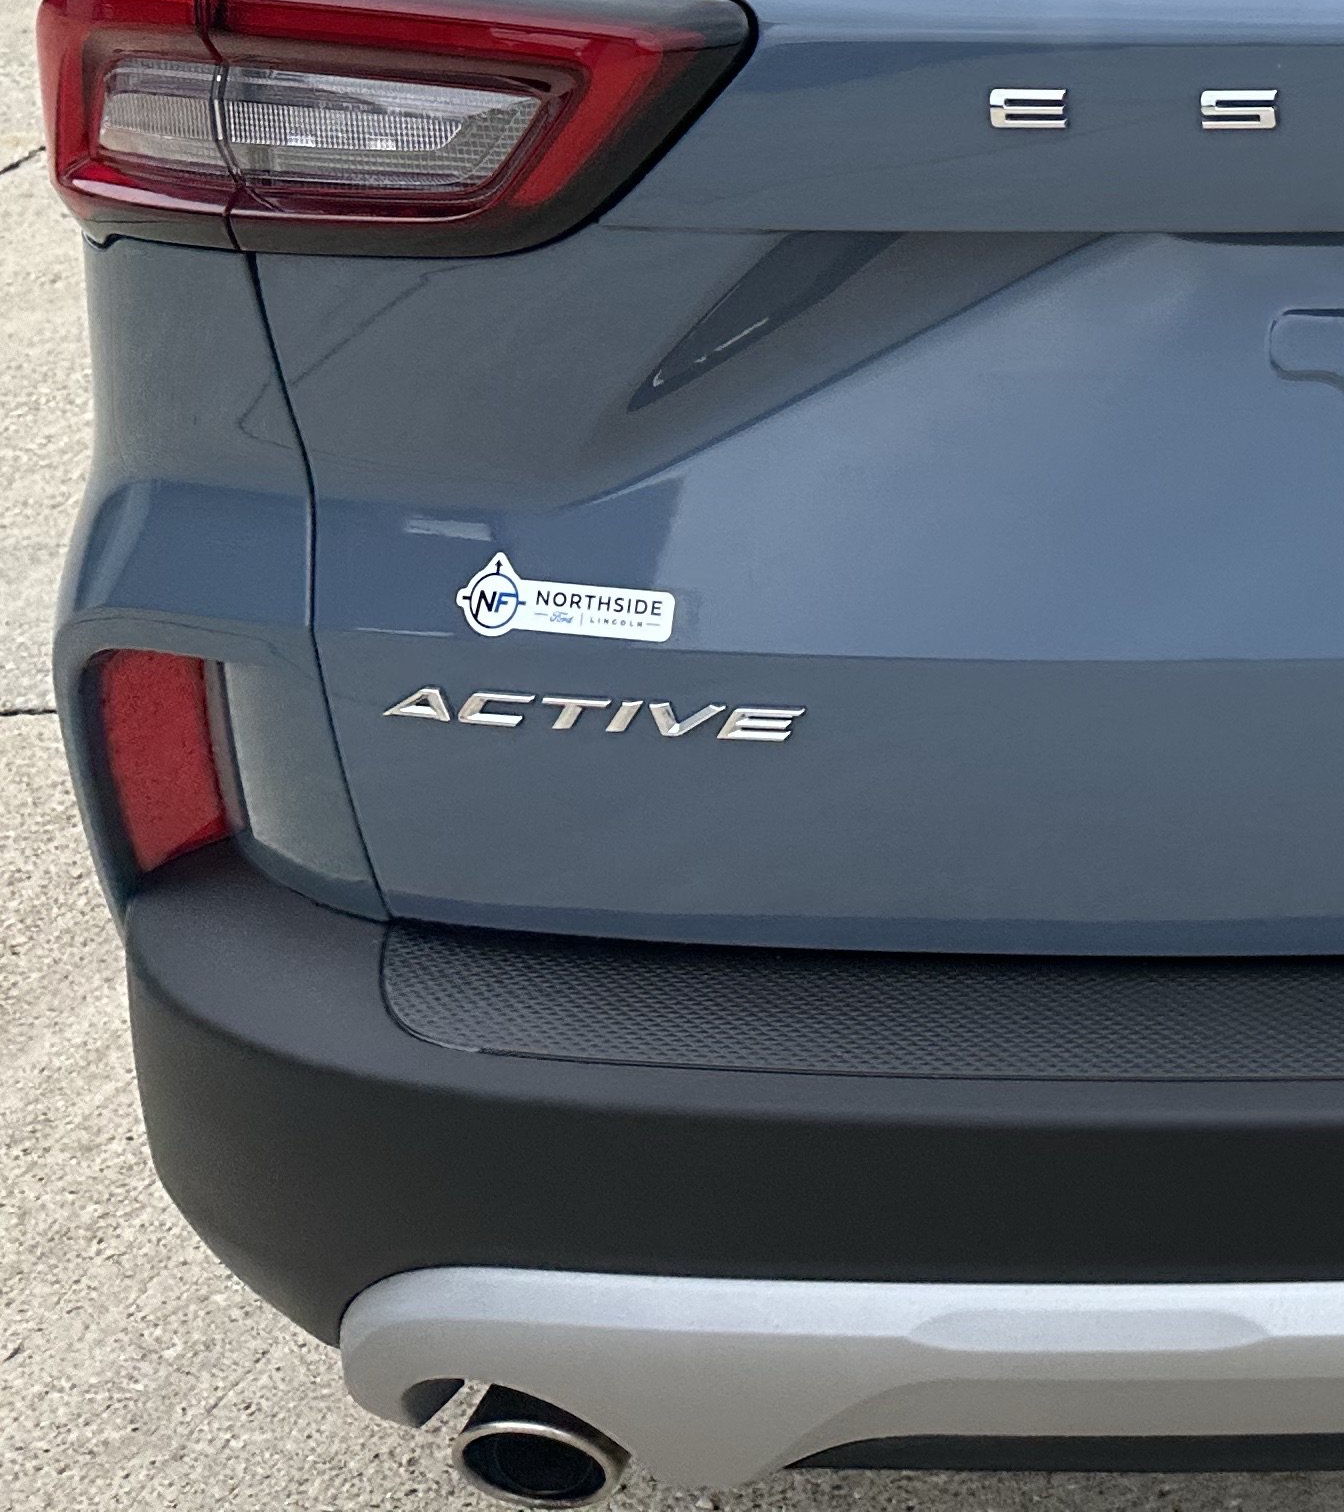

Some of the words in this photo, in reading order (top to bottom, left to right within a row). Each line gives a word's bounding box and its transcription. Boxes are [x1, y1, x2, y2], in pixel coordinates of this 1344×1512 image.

[535, 589, 664, 617] NORTHSIDE
[590, 616, 644, 628] LINCOLN
[382, 686, 807, 742] ACTIVE
